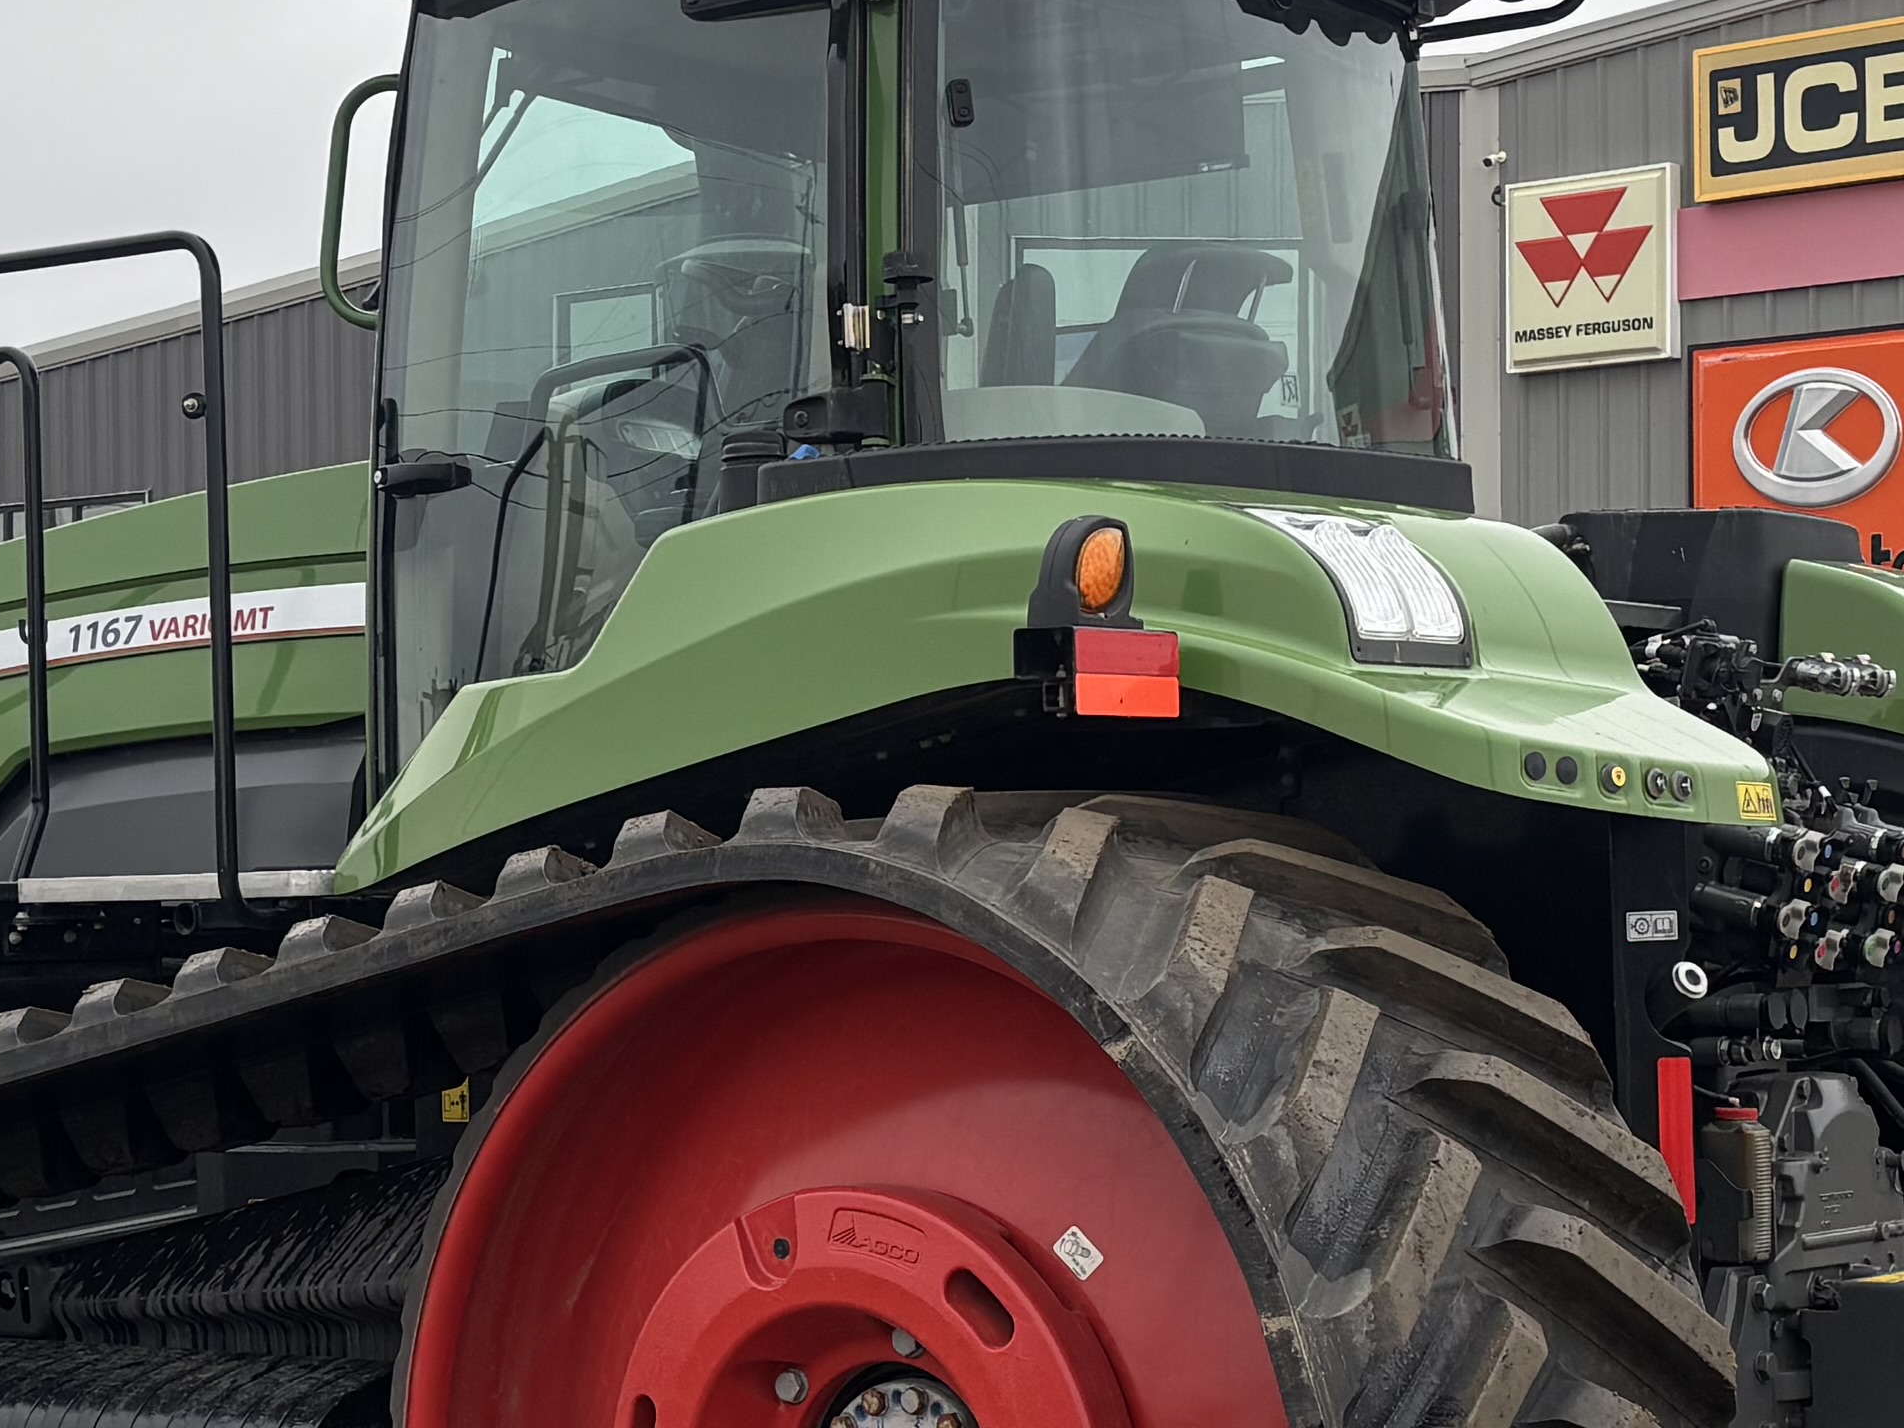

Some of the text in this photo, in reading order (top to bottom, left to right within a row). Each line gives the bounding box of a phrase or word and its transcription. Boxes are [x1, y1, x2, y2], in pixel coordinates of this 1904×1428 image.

[1515, 317, 1653, 343] MASSEY FERGUSON
[69, 606, 274, 653] 1167 VARI MT
[851, 1235, 921, 1264] AGCO
